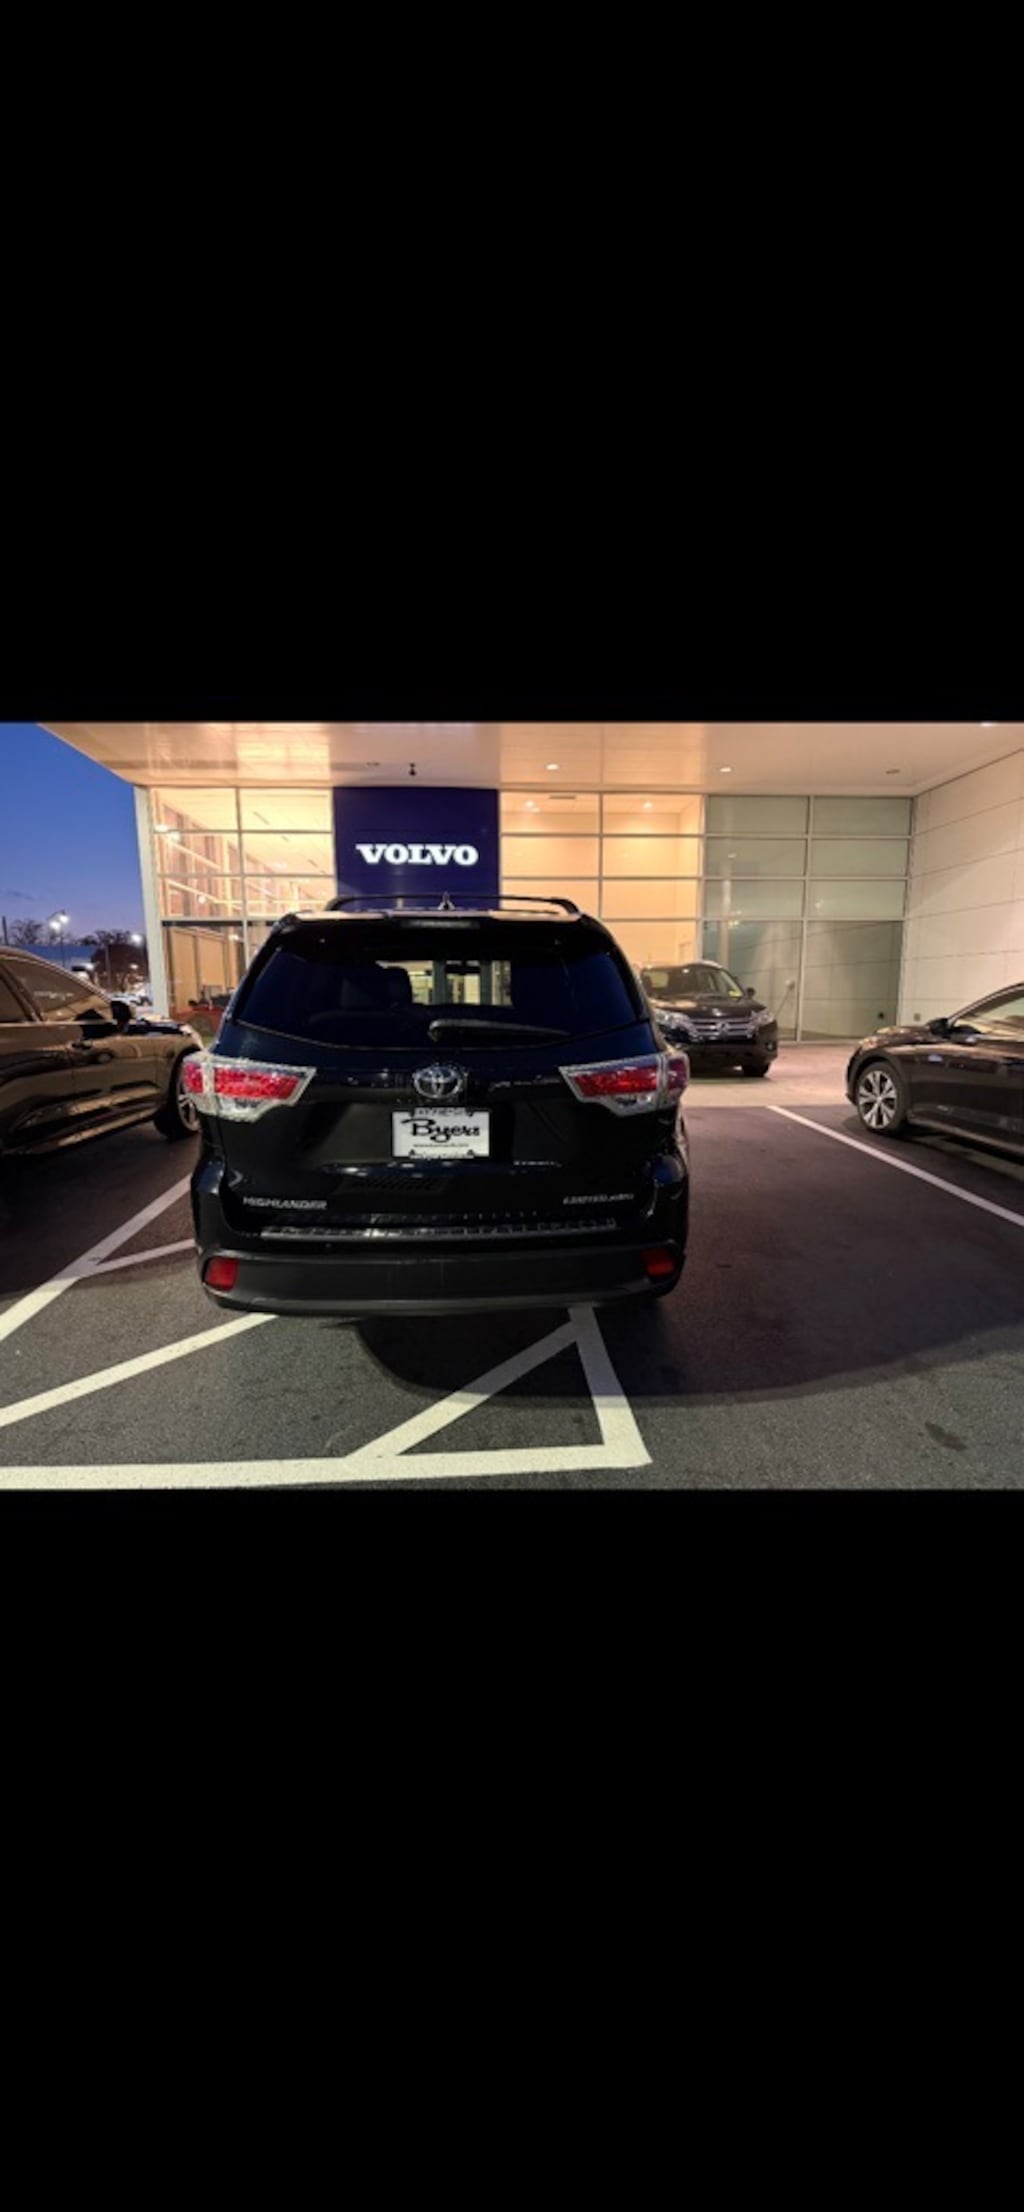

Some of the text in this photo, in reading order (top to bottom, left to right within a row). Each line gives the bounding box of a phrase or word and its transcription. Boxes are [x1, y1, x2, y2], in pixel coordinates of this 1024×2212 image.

[356, 843, 479, 866] VOLVO
[400, 1118, 480, 1143] Byers
[242, 1196, 328, 1211] HIGHLANDER
